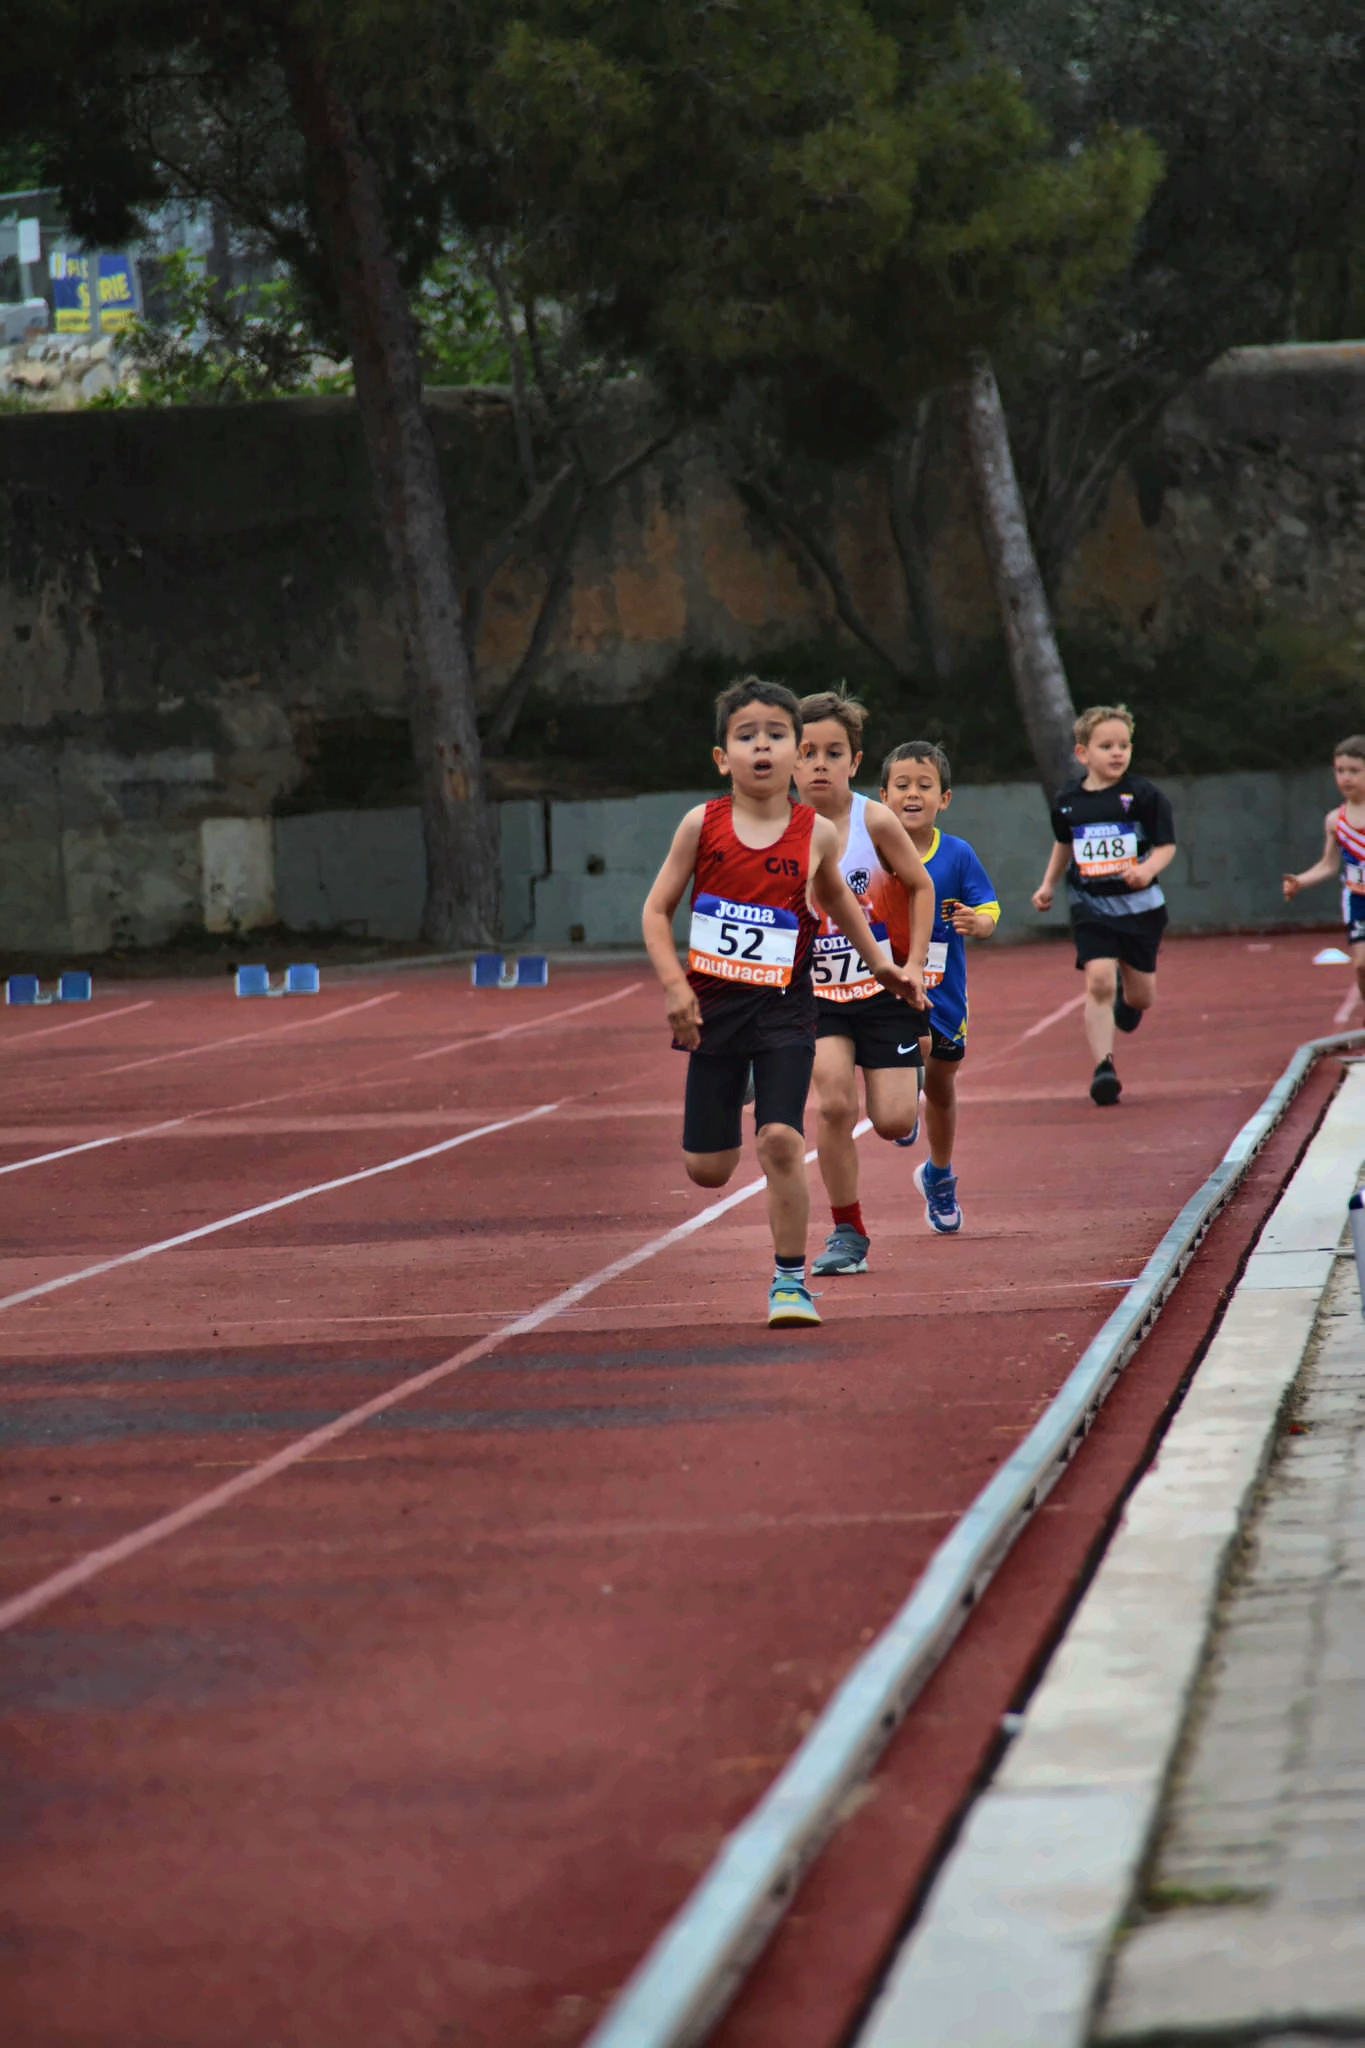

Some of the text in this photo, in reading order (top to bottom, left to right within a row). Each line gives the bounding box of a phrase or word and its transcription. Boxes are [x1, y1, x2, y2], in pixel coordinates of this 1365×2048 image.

[1082, 838, 1126, 860] 448
[717, 922, 764, 961] 52
[812, 935, 854, 953] Jom
[694, 955, 784, 985] mutuacat
[811, 952, 874, 984] 574
